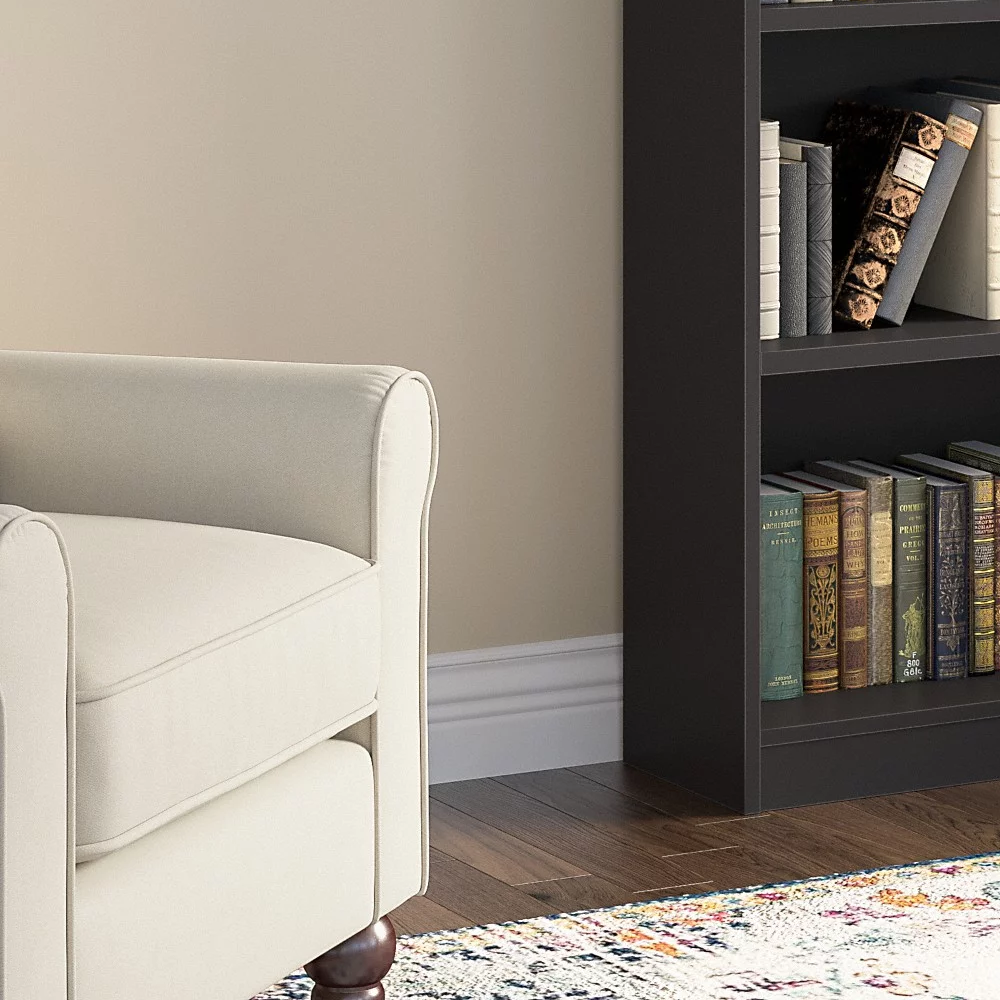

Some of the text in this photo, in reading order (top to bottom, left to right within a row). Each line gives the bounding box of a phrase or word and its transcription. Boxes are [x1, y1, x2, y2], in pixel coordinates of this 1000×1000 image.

[769, 507, 799, 517] INSECT
[805, 536, 838, 548] POEMS
[912, 651, 918, 659] F
[906, 659, 920, 668] 800
